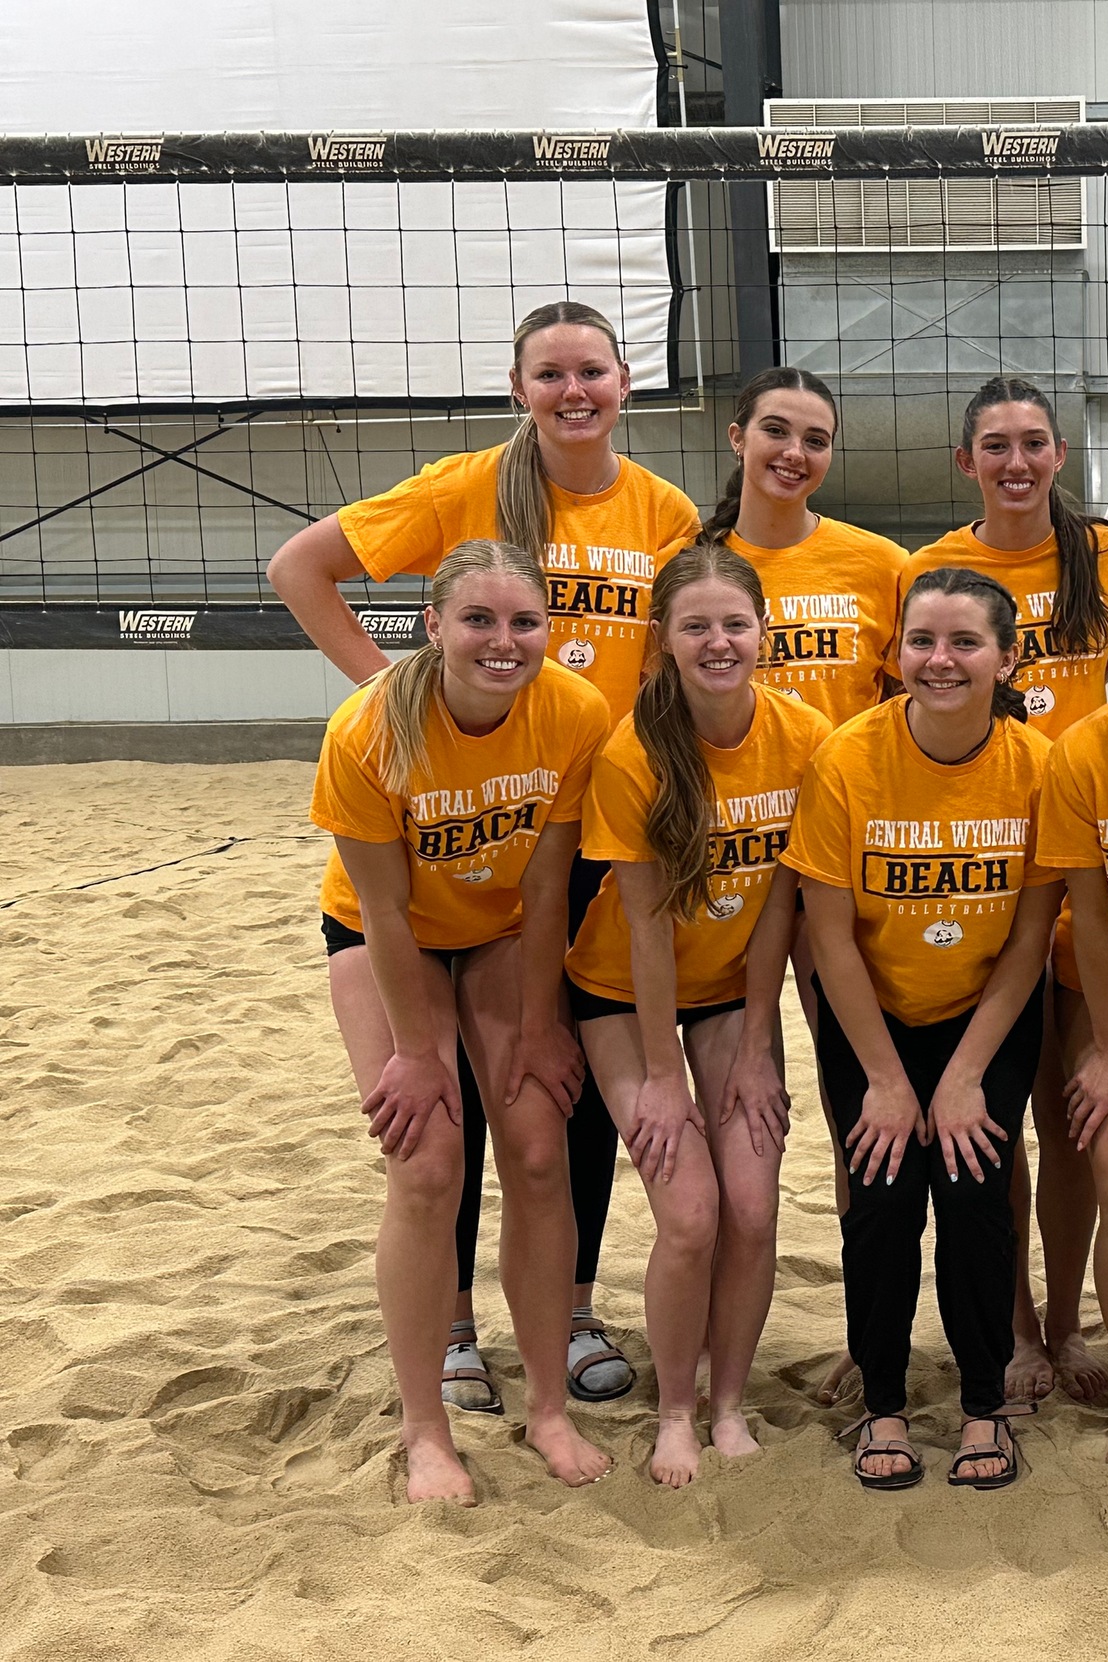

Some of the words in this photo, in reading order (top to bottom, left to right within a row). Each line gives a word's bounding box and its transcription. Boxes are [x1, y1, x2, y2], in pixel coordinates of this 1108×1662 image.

[85, 139, 160, 161] WESTERN
[308, 138, 385, 160] WESTERN
[533, 136, 610, 158] WESTERN
[758, 135, 834, 157] WESTERN
[982, 132, 1058, 154] WESTERN
[89, 162, 111, 170] STEEL
[115, 162, 160, 170] BUILDINGS
[312, 161, 335, 169] STEEL
[339, 161, 383, 169] BUILDINGS
[787, 158, 832, 166] BUILDINGS
[549, 580, 638, 617] EACH
[781, 595, 858, 620] WYOMING
[119, 611, 195, 631] WESTERN
[358, 612, 417, 632] ESTERN
[767, 629, 839, 661] ACH
[411, 790, 475, 821] ENTRAL
[481, 767, 559, 806] WYOMING
[727, 787, 799, 824] WYOMIN
[417, 803, 538, 858] BEACH
[865, 820, 942, 848] CENTRAL
[884, 859, 1008, 893] BEACH
